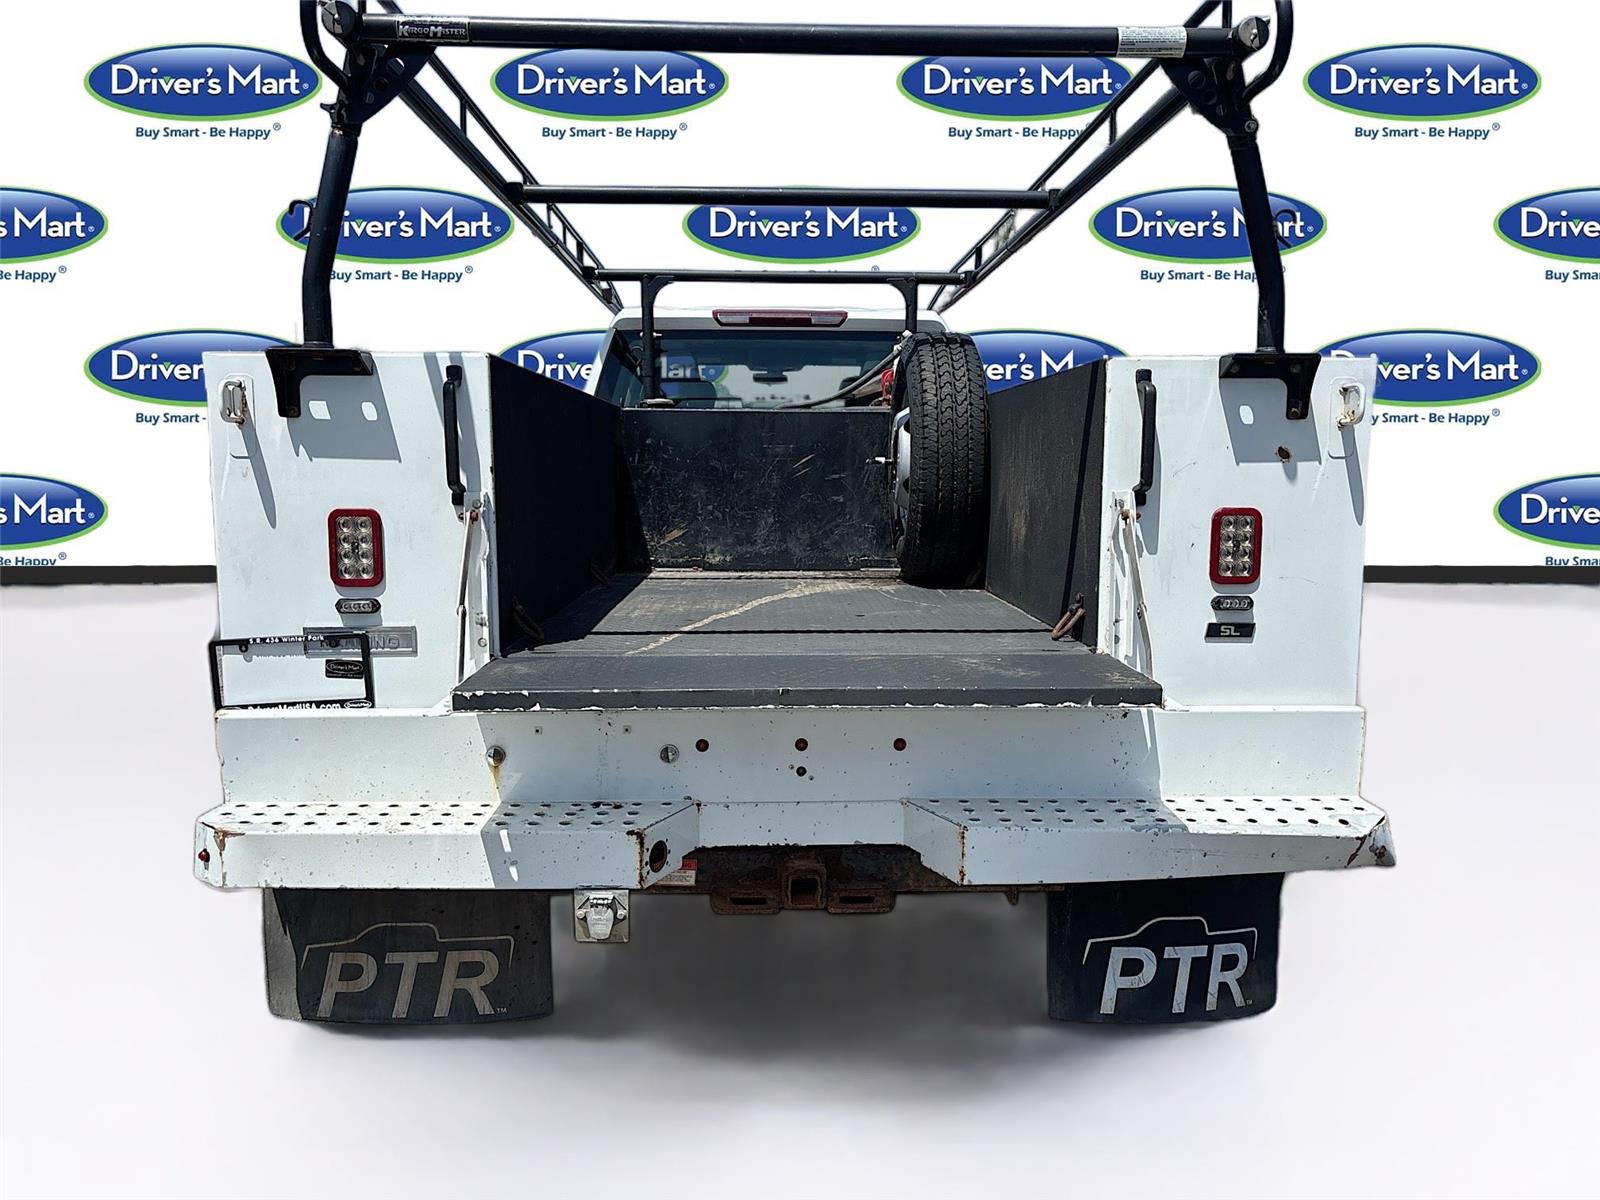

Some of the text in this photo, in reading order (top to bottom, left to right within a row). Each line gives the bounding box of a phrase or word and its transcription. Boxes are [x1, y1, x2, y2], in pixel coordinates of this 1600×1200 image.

[111, 64, 300, 95] Driver's Mart
[517, 63, 706, 94] Driver's Mart
[924, 64, 1113, 95] Driver's Mart
[1330, 64, 1519, 95] Driver's Mart
[136, 127, 160, 140] Buy
[163, 127, 200, 138] Smart
[210, 127, 226, 138] Be
[229, 127, 271, 140] Happy
[542, 126, 566, 139] Buy
[569, 126, 606, 137] Smart
[616, 126, 632, 137] Be
[635, 126, 677, 139] Happy
[949, 127, 973, 140] Buy
[976, 127, 1013, 138] Smart
[1023, 127, 1039, 138] Be
[1042, 127, 1084, 140] Happy
[1354, 127, 1378, 140] Buy
[1381, 127, 1418, 138] Smart
[1428, 127, 1444, 138] Be
[1447, 127, 1489, 140] Happy
[14, 206, 86, 238] Mart
[420, 206, 492, 238] Mart
[709, 207, 898, 238] Driver's Mart
[1116, 207, 1227, 238] Driver's
[15, 270, 57, 283] Happy
[355, 270, 392, 281] Smart
[402, 270, 418, 281] Be
[421, 270, 463, 283] Happy
[1140, 270, 1165, 283] Buy
[1168, 270, 1205, 281] Smart
[1215, 270, 1231, 281] Be
[1234, 270, 1259, 282] Hap
[1545, 270, 1570, 283] Buy
[111, 350, 204, 381] Driver
[660, 354, 706, 380] art
[1447, 350, 1519, 381] Mart
[136, 413, 160, 426] Buy
[163, 413, 200, 424] Smart
[1382, 413, 1419, 424] Smart
[1429, 413, 1445, 424] Be
[1448, 413, 1490, 426] Happy
[14, 493, 86, 524] Mart
[281, 635, 306, 643] Winter
[308, 634, 325, 642] Park
[1220, 625, 1241, 636] SL
[317, 950, 500, 1018] PTR
[1100, 942, 1248, 1014] PTR
